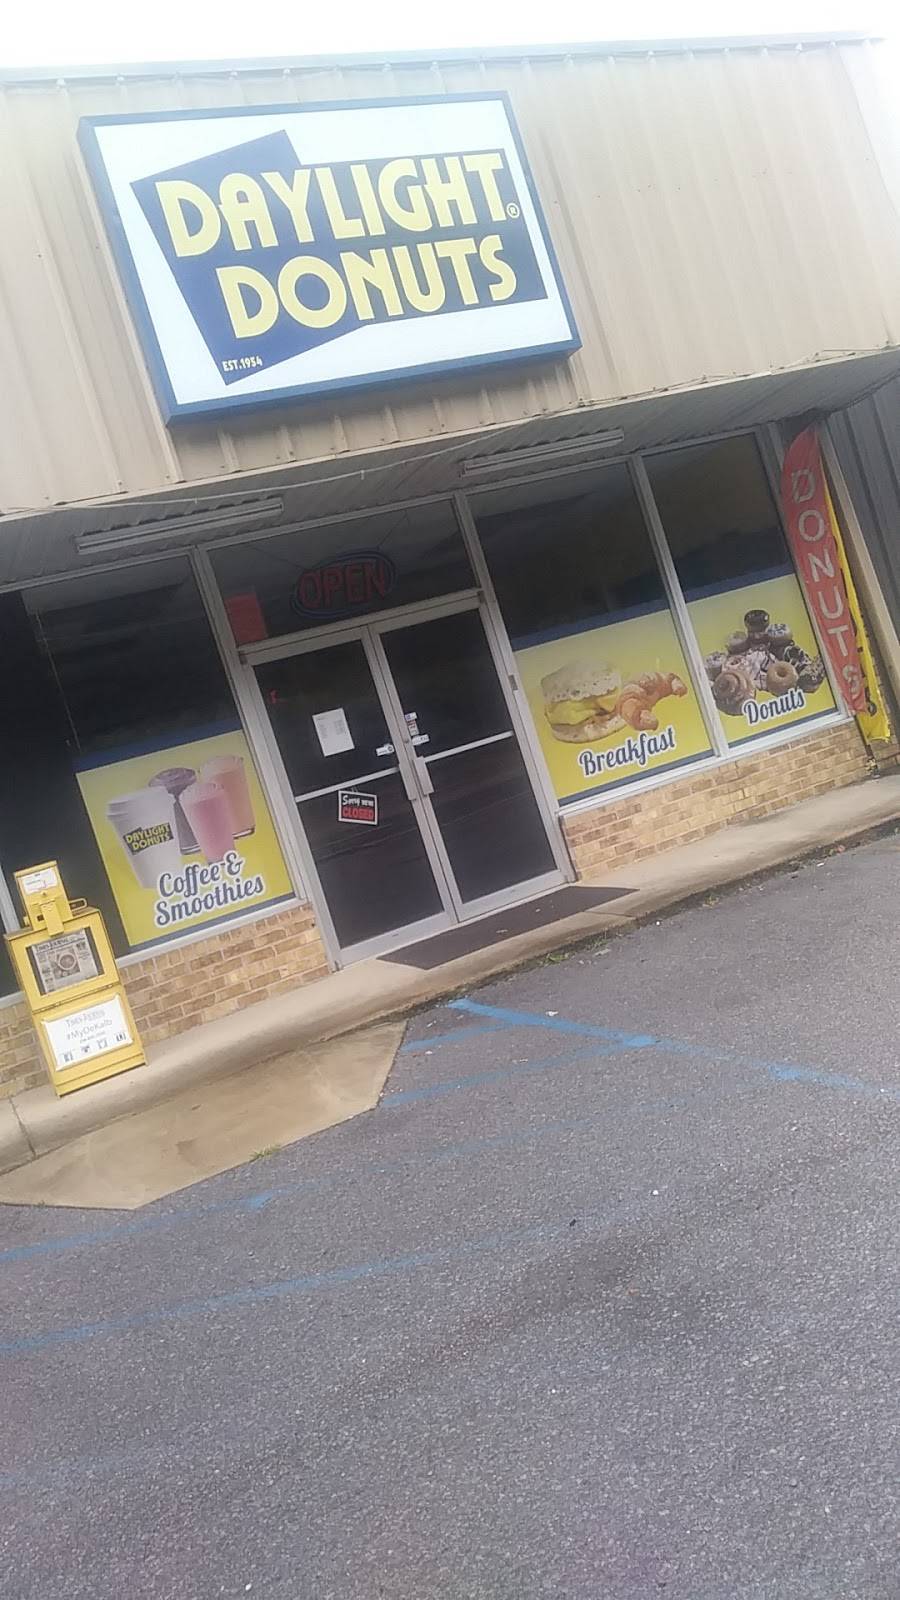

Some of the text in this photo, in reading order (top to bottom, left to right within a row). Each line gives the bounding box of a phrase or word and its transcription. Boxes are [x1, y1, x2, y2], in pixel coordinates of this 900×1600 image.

[155, 152, 506, 257] DAYLIGHT
[216, 233, 518, 339] DONUTS
[300, 559, 385, 609] OPEN
[791, 468, 859, 695] DONUTS
[743, 690, 805, 724] Donuts
[579, 727, 675, 776] Breakfast
[125, 823, 170, 844] DAYLIGHT
[342, 805, 375, 820] CLOSED
[131, 832, 170, 850] DONUTS
[159, 852, 244, 898] Coffee &
[156, 876, 264, 926] Smoothies
